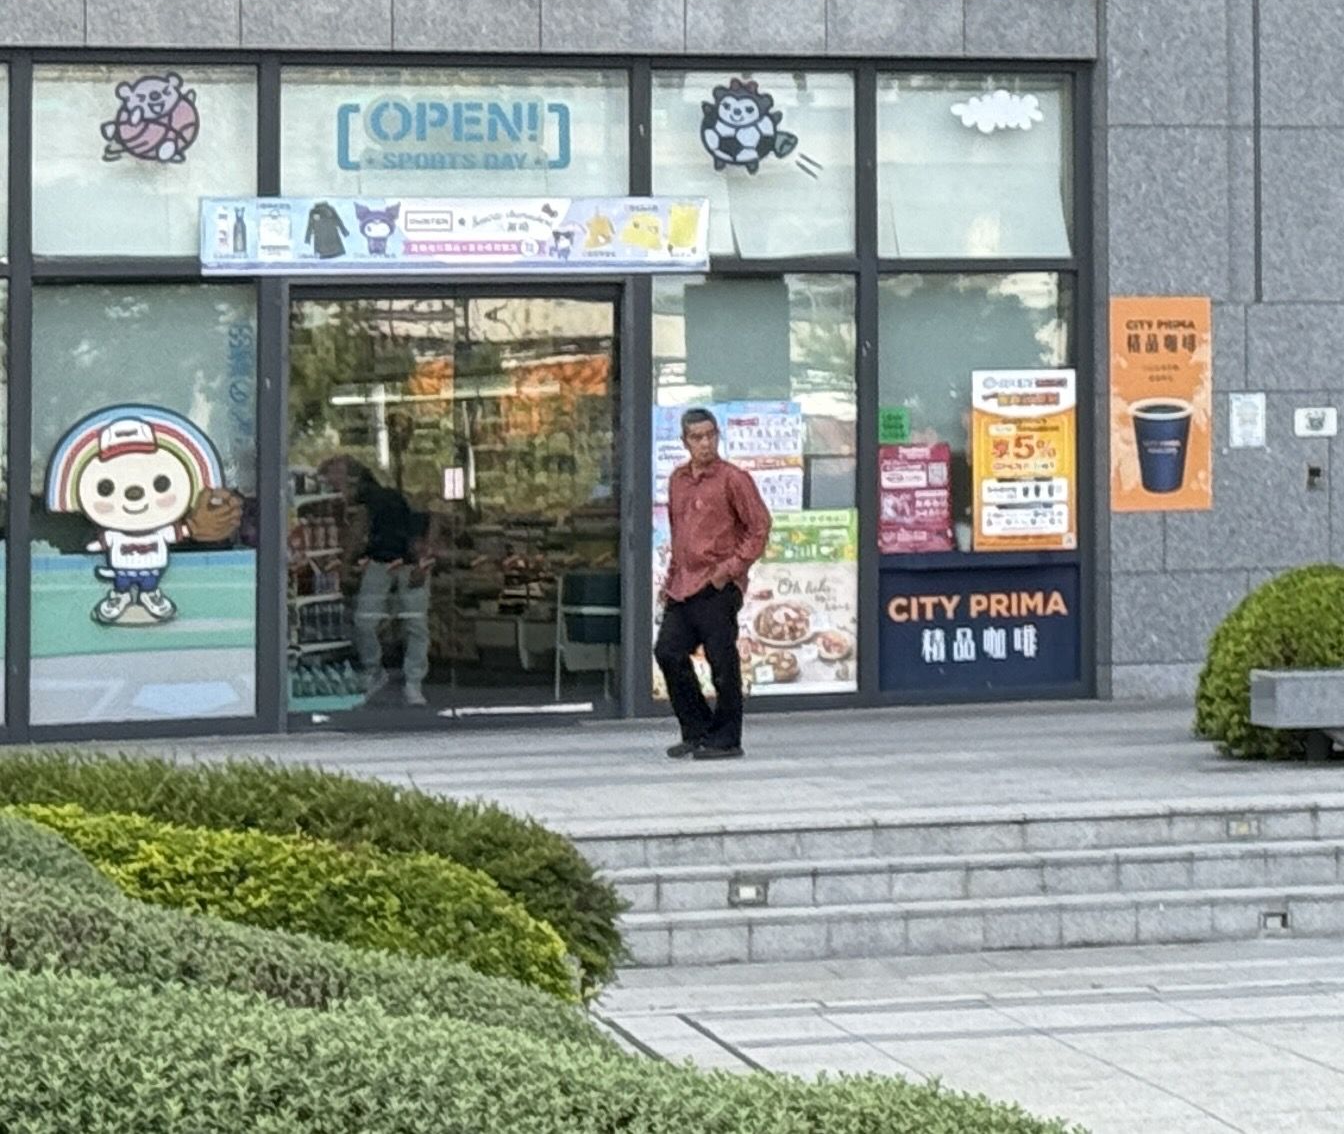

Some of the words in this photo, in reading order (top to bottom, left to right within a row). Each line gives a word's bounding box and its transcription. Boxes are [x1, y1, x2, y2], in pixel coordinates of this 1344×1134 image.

[369, 100, 540, 142] OPEN!
[382, 152, 477, 170] SPORTS
[484, 152, 528, 170] DAY
[888, 595, 961, 623] CITY
[970, 590, 1068, 619] PRIMA
[921, 624, 1038, 663] 精品咖啡
